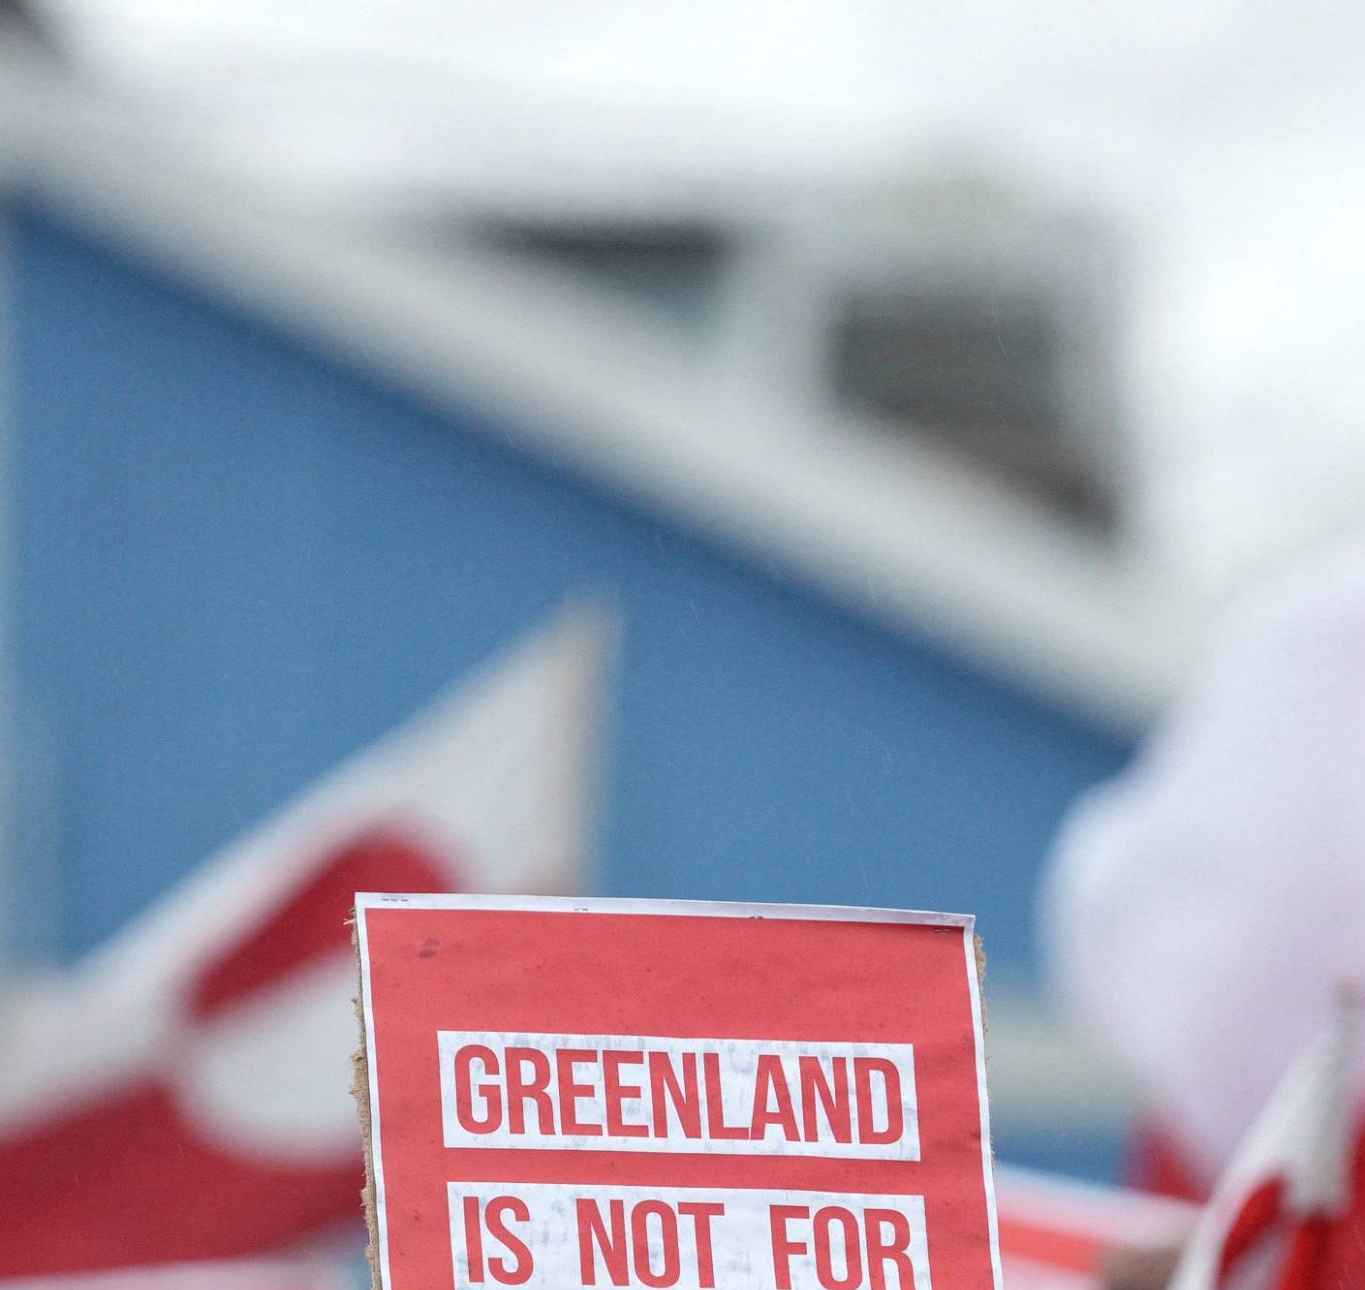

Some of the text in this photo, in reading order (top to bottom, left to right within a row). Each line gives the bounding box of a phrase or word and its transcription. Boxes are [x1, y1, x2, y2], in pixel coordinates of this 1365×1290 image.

[455, 1044, 904, 1145] GREENLAND
[464, 1196, 534, 1285] IS
[576, 1198, 726, 1289] NOT
